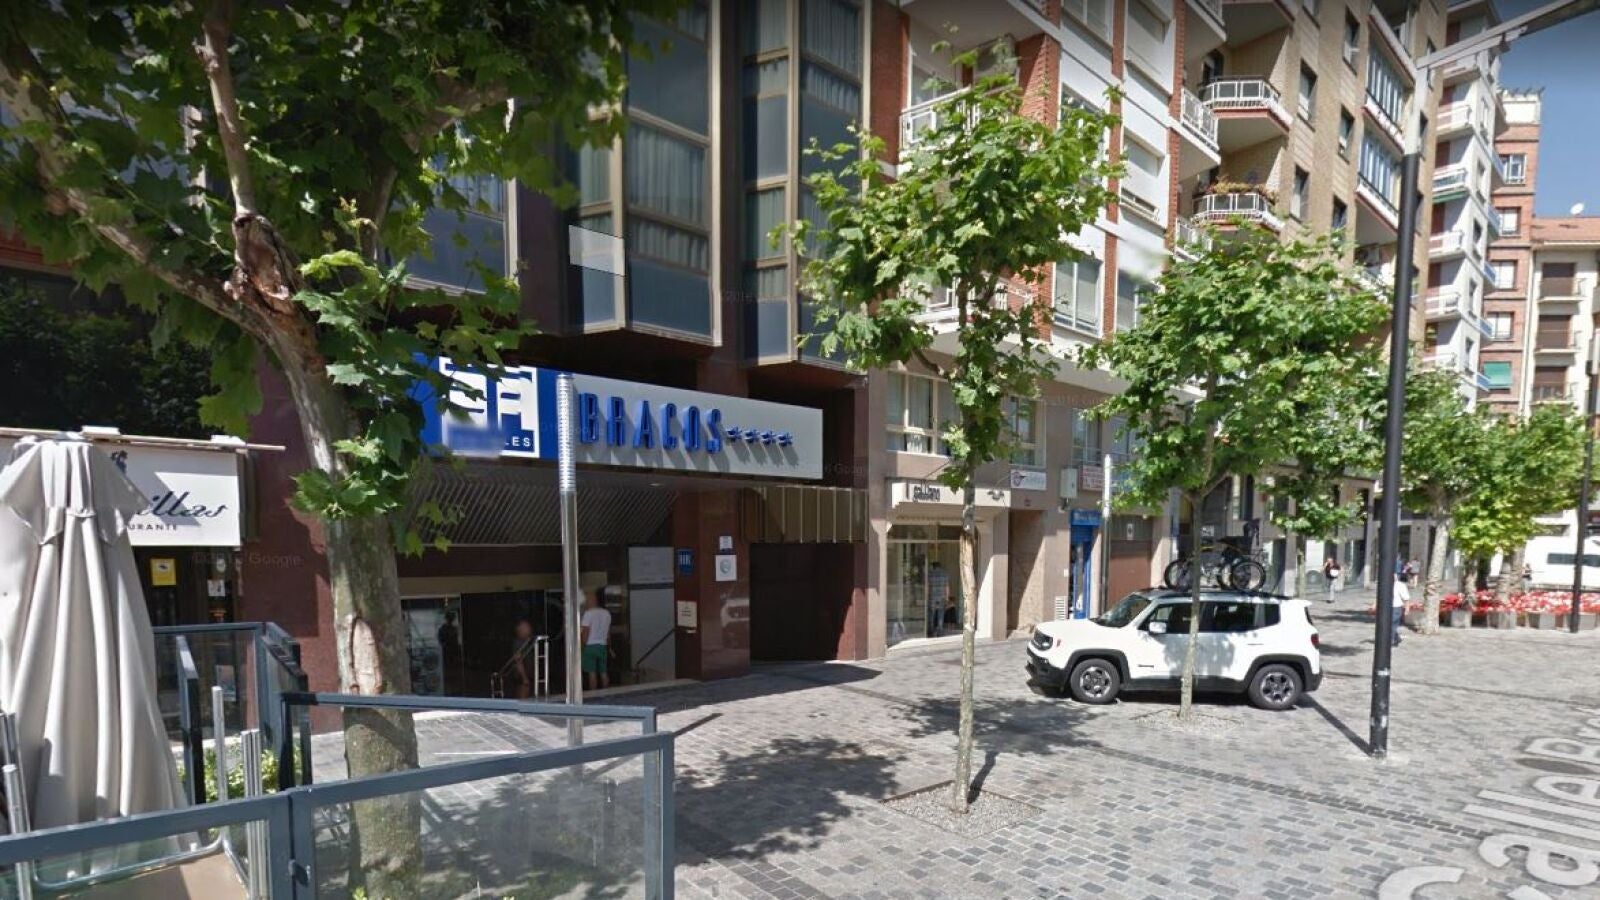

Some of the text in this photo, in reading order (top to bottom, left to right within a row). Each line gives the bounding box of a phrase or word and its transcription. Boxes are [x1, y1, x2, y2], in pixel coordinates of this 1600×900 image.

[579, 391, 722, 454] BRACOS
[137, 490, 227, 518] illas
[128, 523, 177, 532] URANTE
